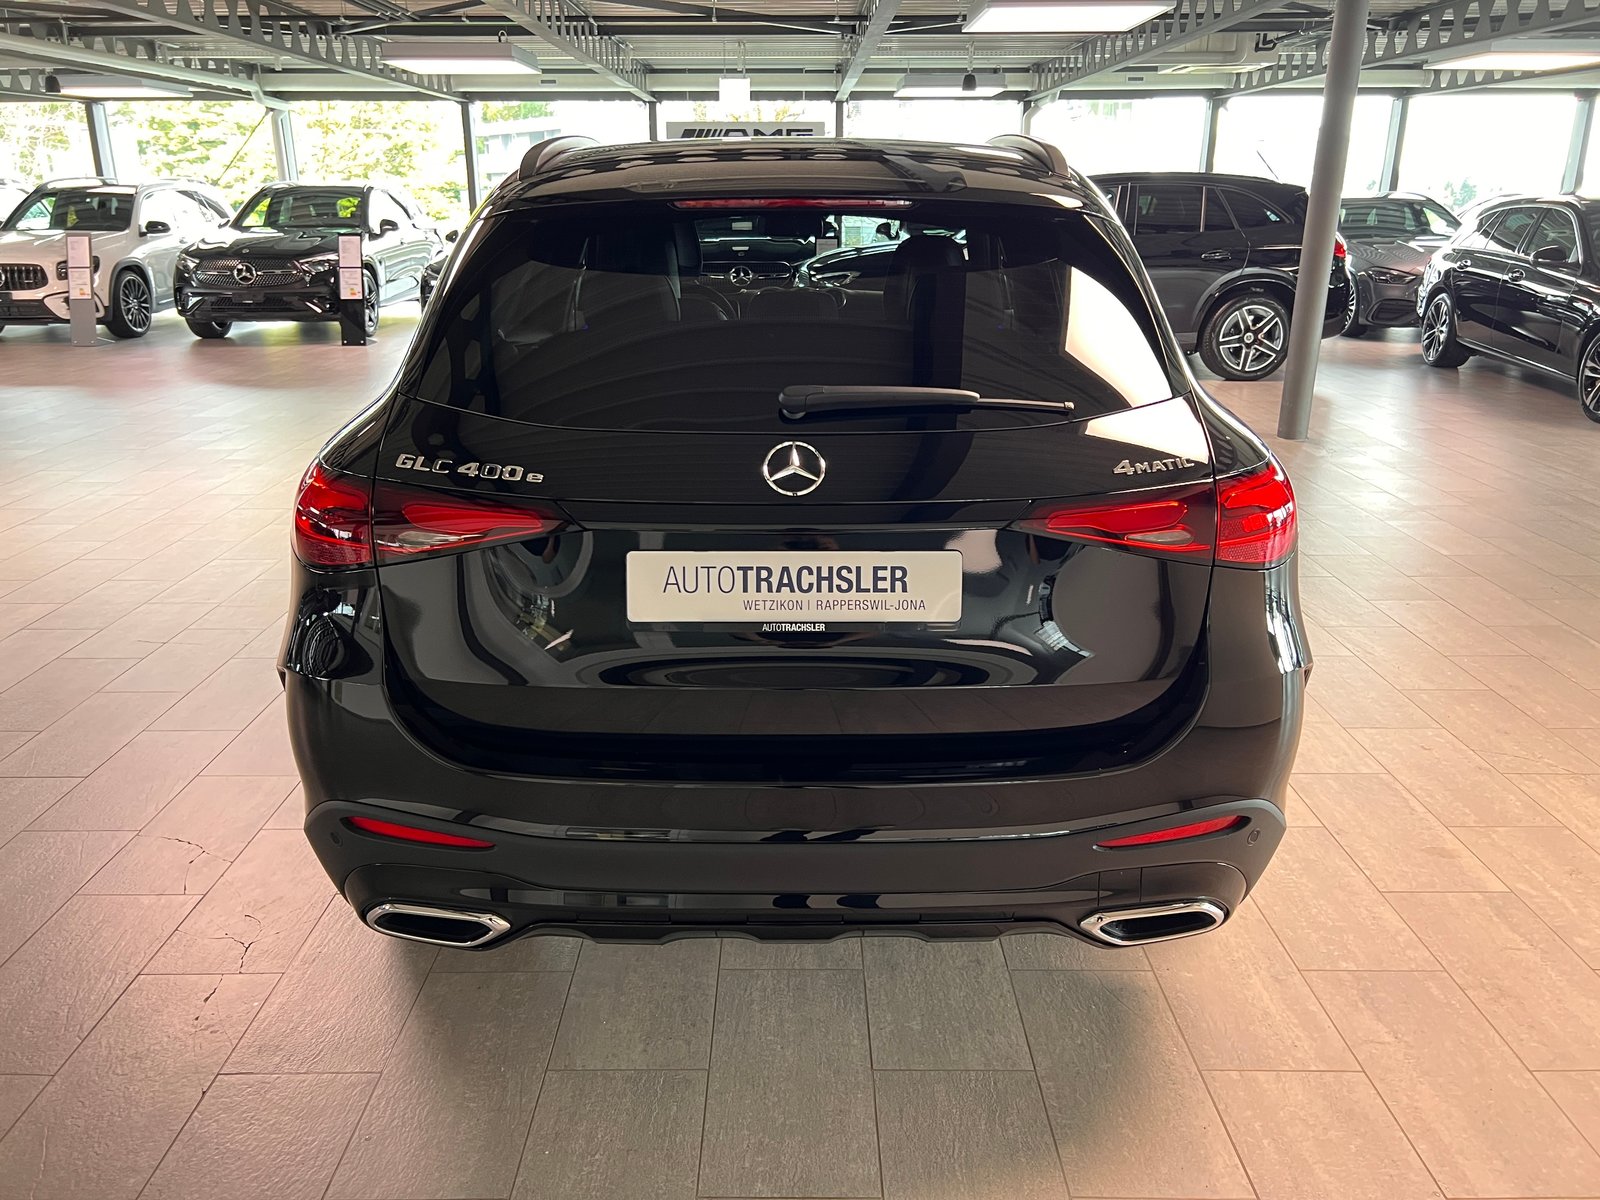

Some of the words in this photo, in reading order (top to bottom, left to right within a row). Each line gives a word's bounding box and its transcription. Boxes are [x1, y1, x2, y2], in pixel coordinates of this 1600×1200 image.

[395, 453, 453, 474] GLC
[1112, 457, 1195, 475] 4MATIC
[663, 565, 908, 594] AUTOTRACHSLER
[743, 600, 803, 611] WETZIKON
[816, 600, 926, 611] RAPPERSWIL-JONA
[762, 623, 826, 632] AUTOTRACHSLER
